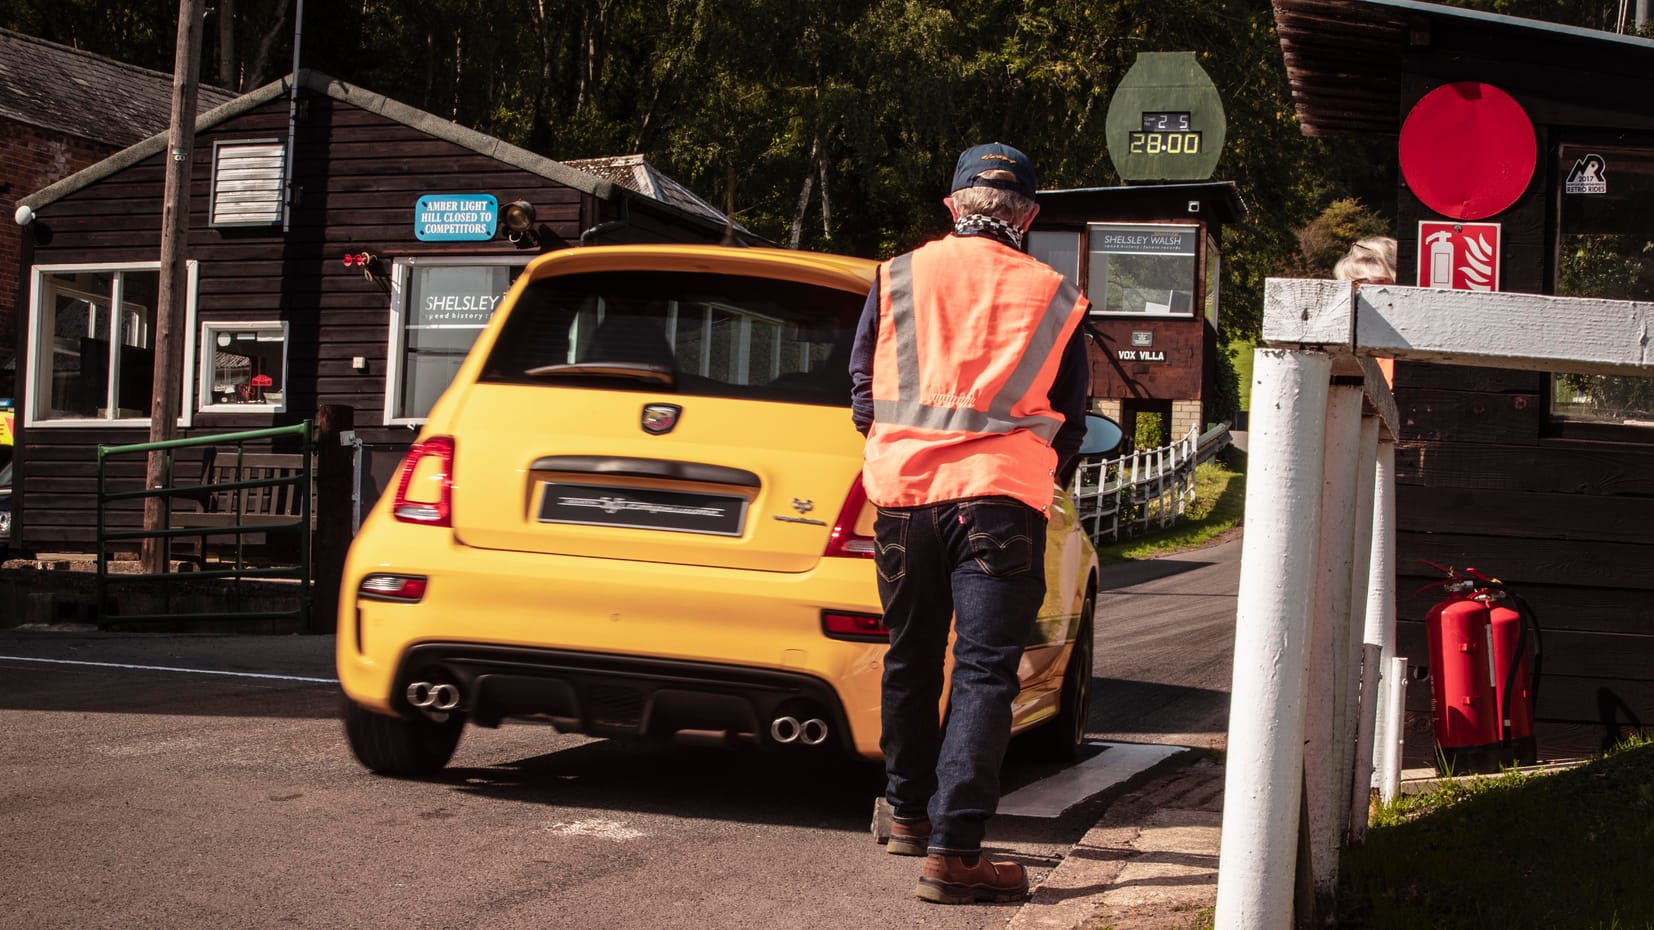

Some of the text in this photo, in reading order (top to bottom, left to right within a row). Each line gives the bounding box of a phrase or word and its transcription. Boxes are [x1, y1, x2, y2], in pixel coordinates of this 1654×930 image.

[1130, 134, 1199, 154] 28.00
[426, 201, 487, 212] AMBER LIGHT
[421, 212, 492, 222] HILL CLOSED TO
[425, 224, 486, 234] COMPETITORS
[1104, 235, 1182, 245] SHELSLEY WALSH
[425, 296, 499, 310] SHELSLEY
[1118, 351, 1164, 360] VOX VILLA
